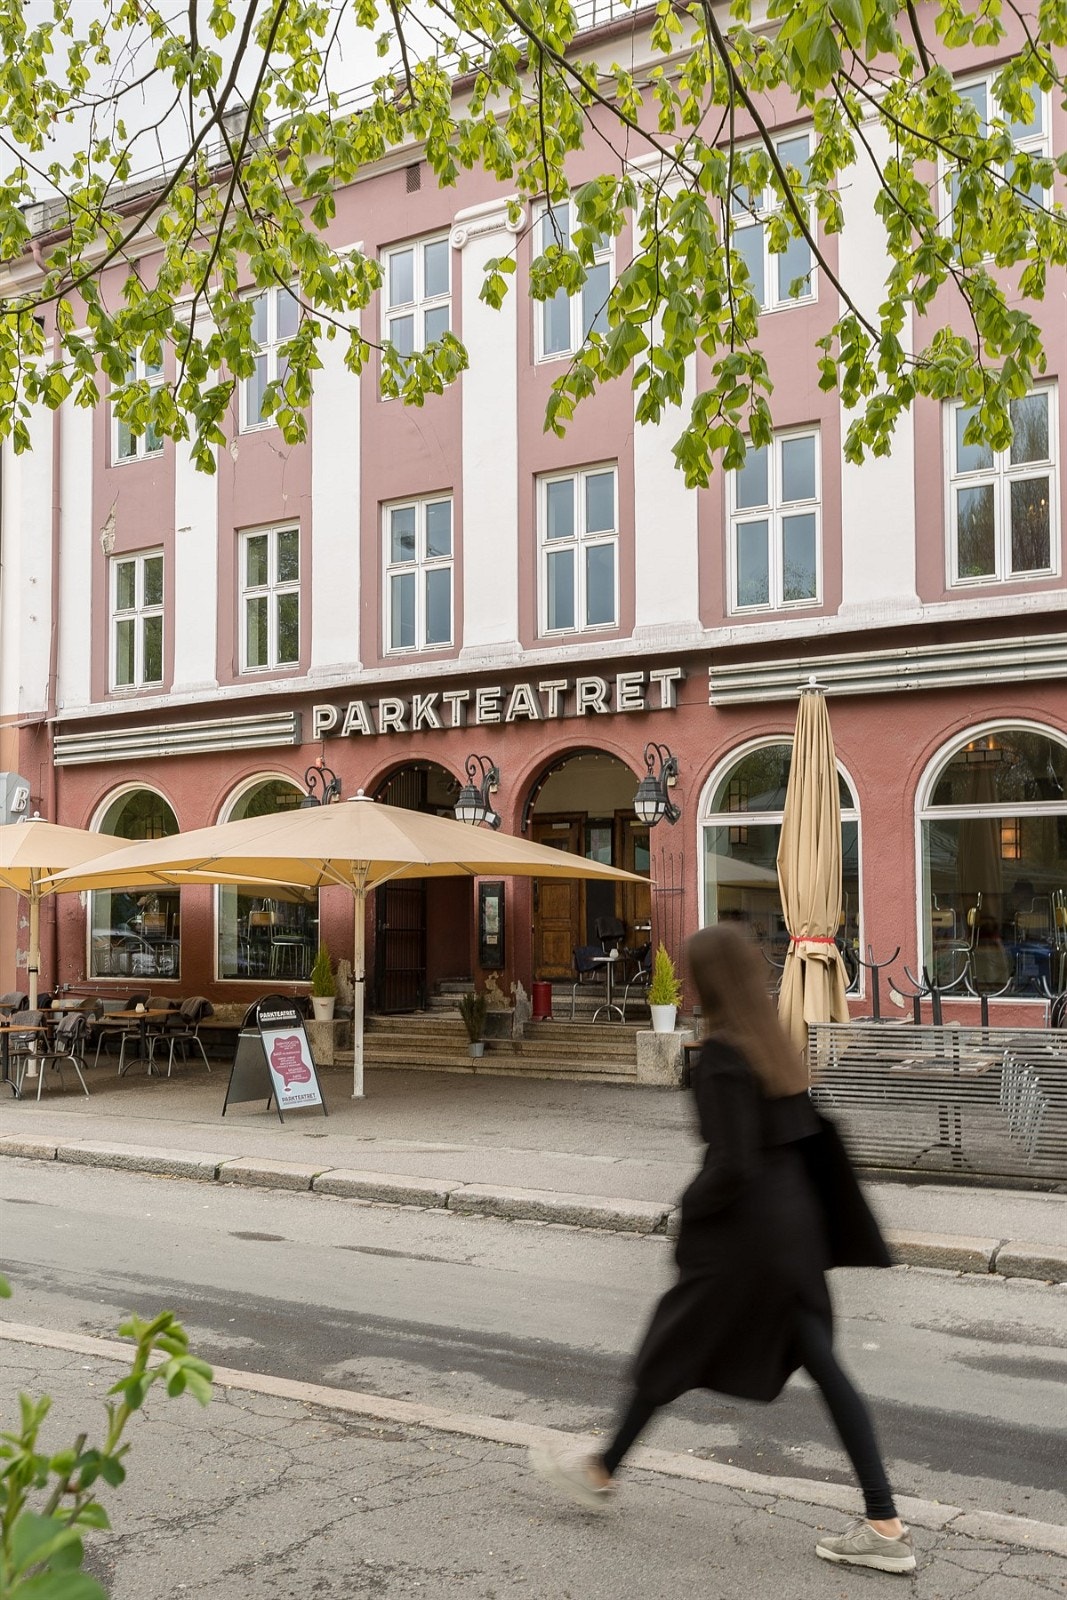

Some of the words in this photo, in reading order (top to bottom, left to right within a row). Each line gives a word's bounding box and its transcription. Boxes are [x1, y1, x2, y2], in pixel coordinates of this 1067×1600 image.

[312, 667, 684, 740] PARKTEATRET
[11, 786, 29, 824] B
[259, 1010, 296, 1018] PARKTEATRET
[281, 1092, 316, 1102] PARKTEATRET
